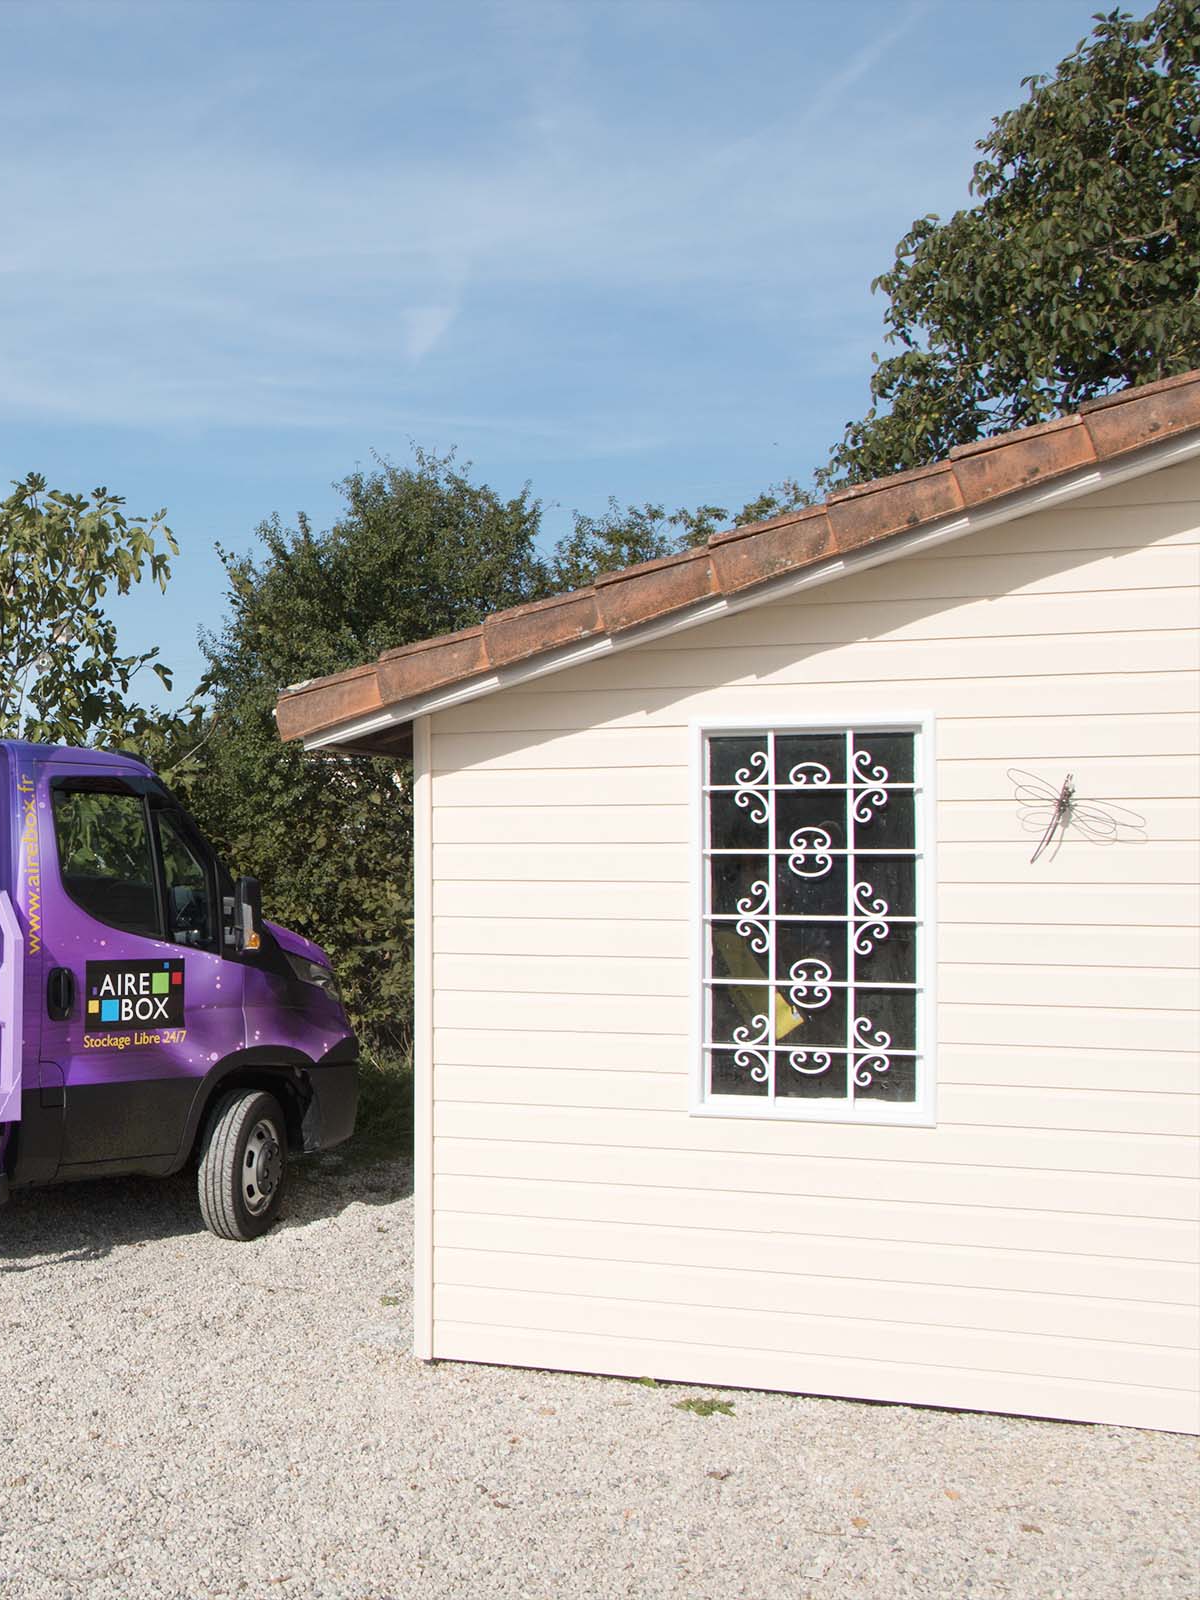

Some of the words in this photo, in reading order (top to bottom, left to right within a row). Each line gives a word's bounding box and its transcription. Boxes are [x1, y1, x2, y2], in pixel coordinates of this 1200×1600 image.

[16, 773, 42, 956] www.airebox.fr
[99, 972, 150, 997] AIRE
[121, 996, 169, 1021] BOX
[83, 1033, 131, 1050] Stockage
[134, 1031, 161, 1046] Libre
[162, 1029, 187, 1044] 24/7
